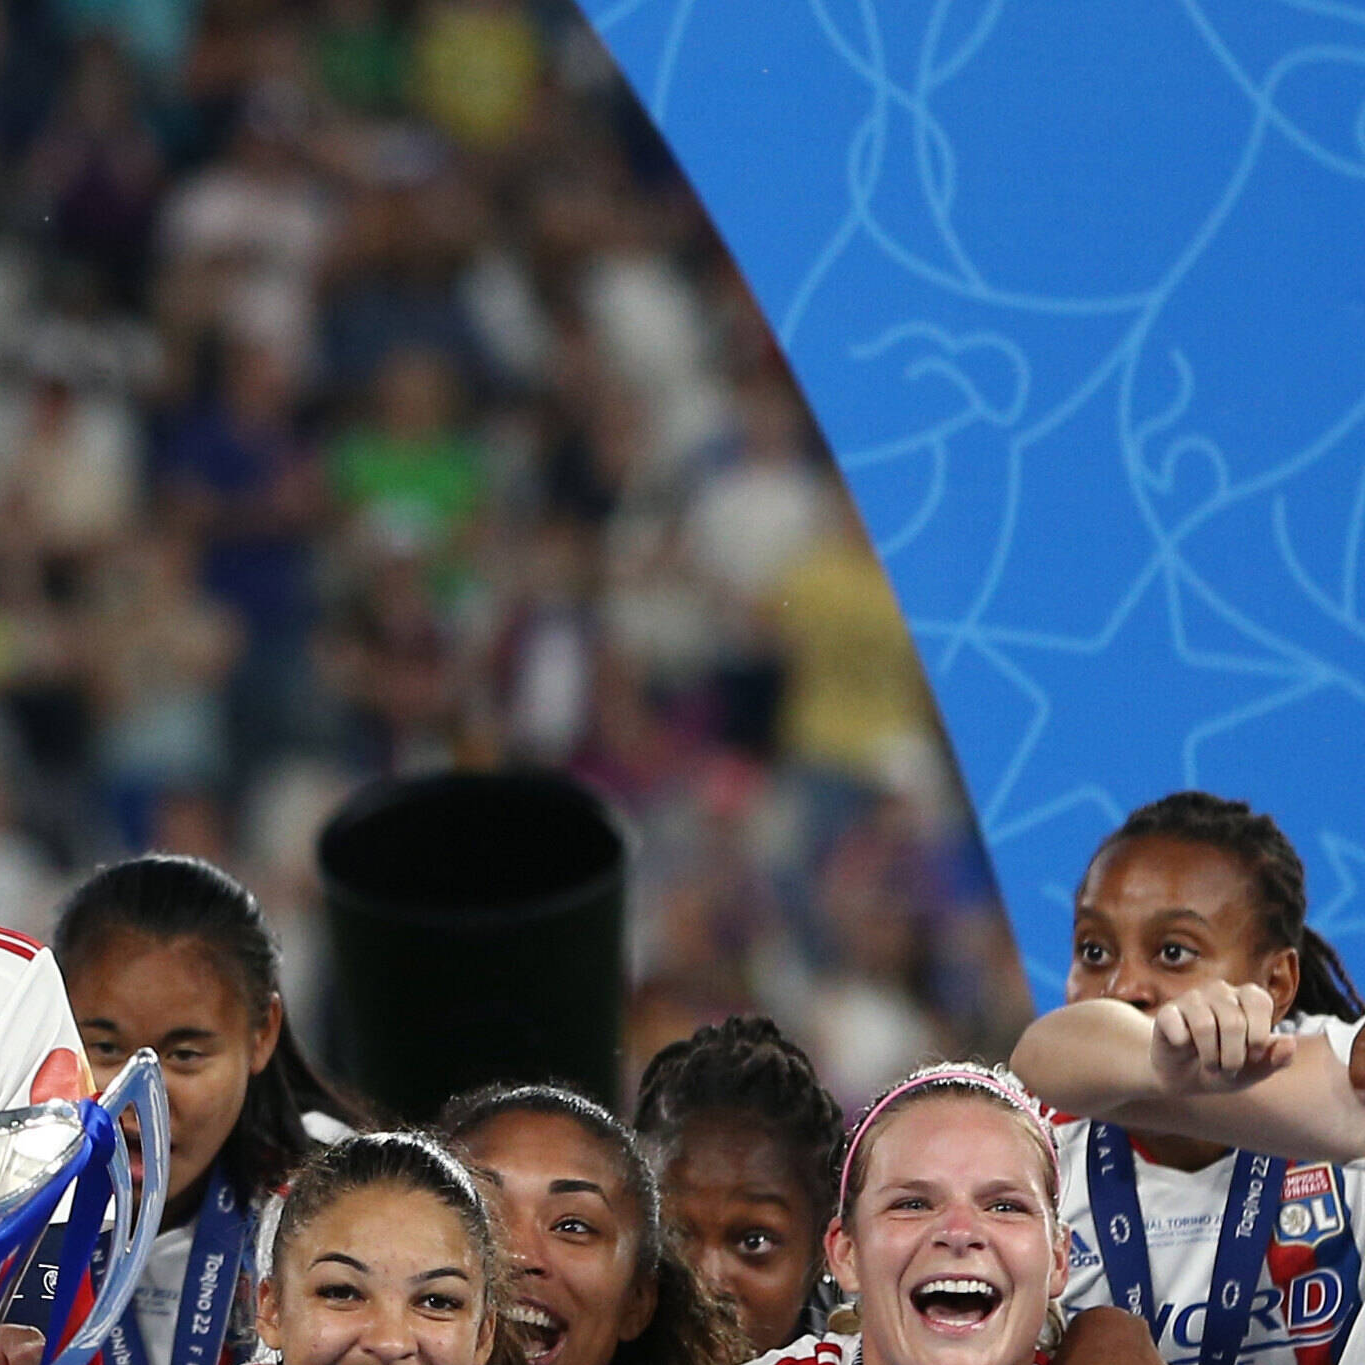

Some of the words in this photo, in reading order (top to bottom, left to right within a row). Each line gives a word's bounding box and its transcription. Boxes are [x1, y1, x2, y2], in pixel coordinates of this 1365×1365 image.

[1095, 1125, 1115, 1176] NAL
[1236, 1180, 1265, 1239] TORINO
[1252, 1155, 1271, 1177] 22
[1280, 1199, 1338, 1237] OL
[196, 1253, 224, 1311] TORINO
[192, 1312, 211, 1335] 22
